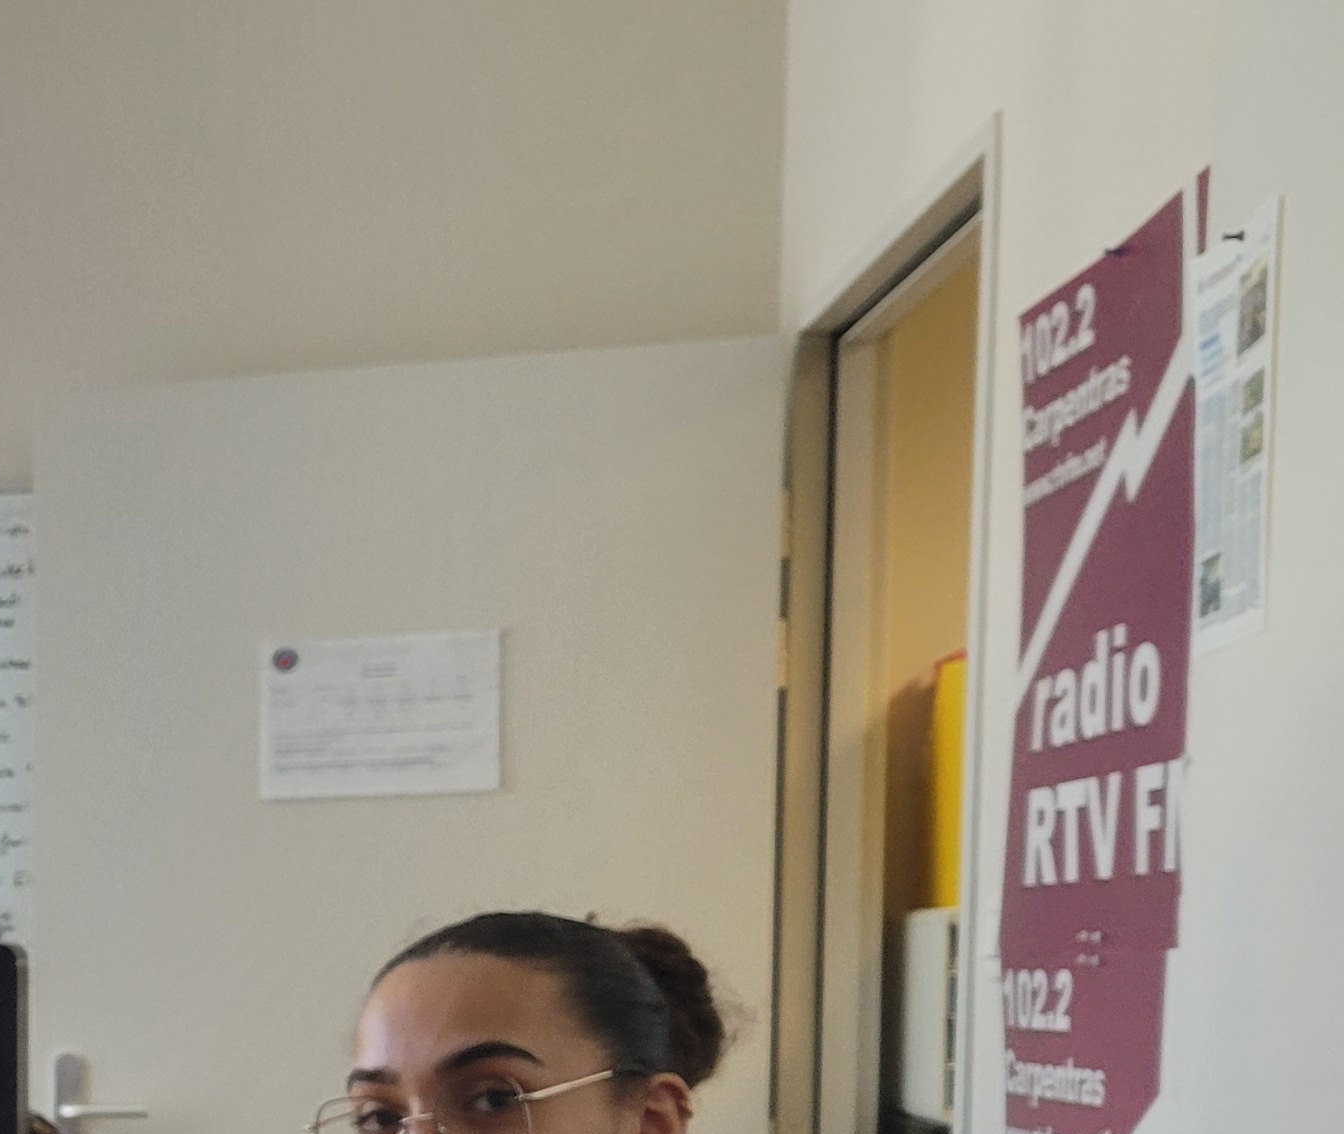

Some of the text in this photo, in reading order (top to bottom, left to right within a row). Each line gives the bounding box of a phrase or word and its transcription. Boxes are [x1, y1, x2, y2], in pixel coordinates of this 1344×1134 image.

[1022, 283, 1097, 384] 102.2
[1030, 622, 1161, 752] radio
[1023, 771, 1122, 887] RTV
[1005, 968, 1074, 1032] 102.2
